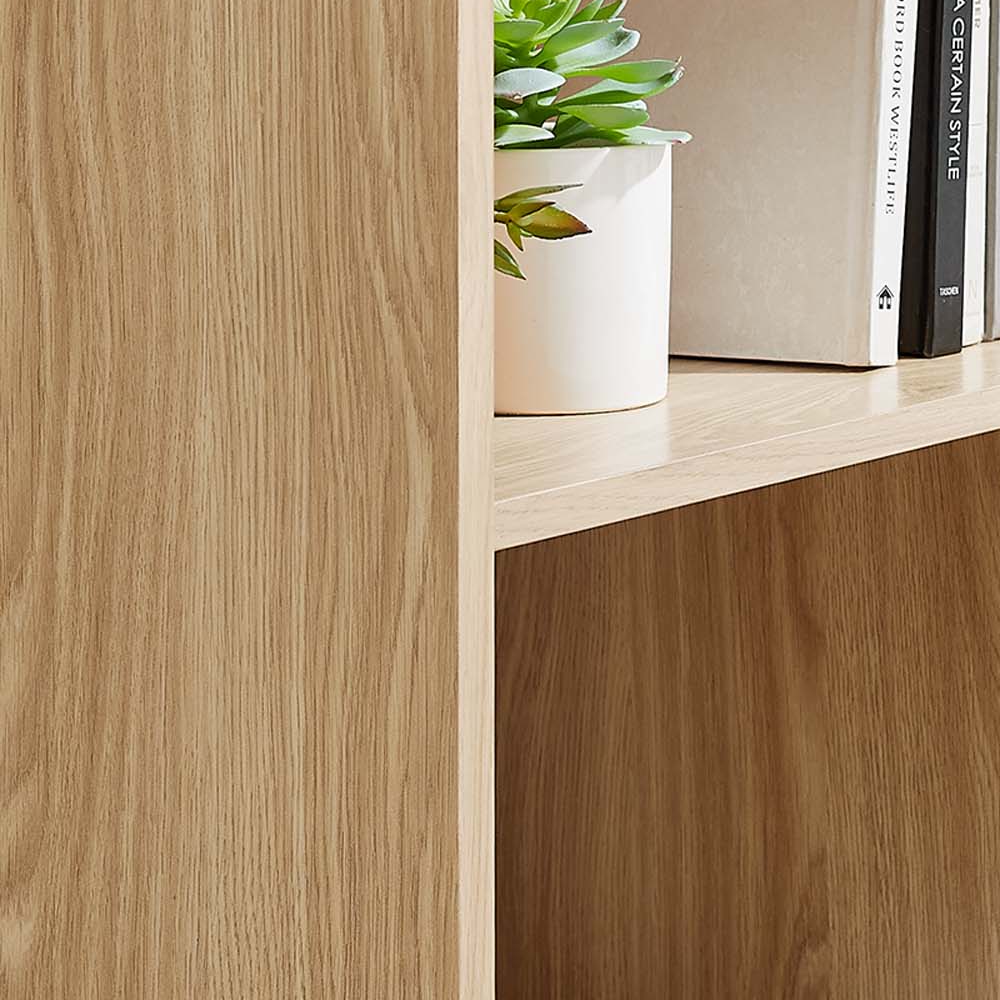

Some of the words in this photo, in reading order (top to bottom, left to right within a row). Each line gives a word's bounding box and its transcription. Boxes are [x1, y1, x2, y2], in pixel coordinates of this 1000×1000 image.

[891, 40, 903, 98] BOOK
[950, 17, 965, 114] CERTAIN
[885, 106, 900, 215] WESTLIFE
[947, 119, 962, 180] STYLE
